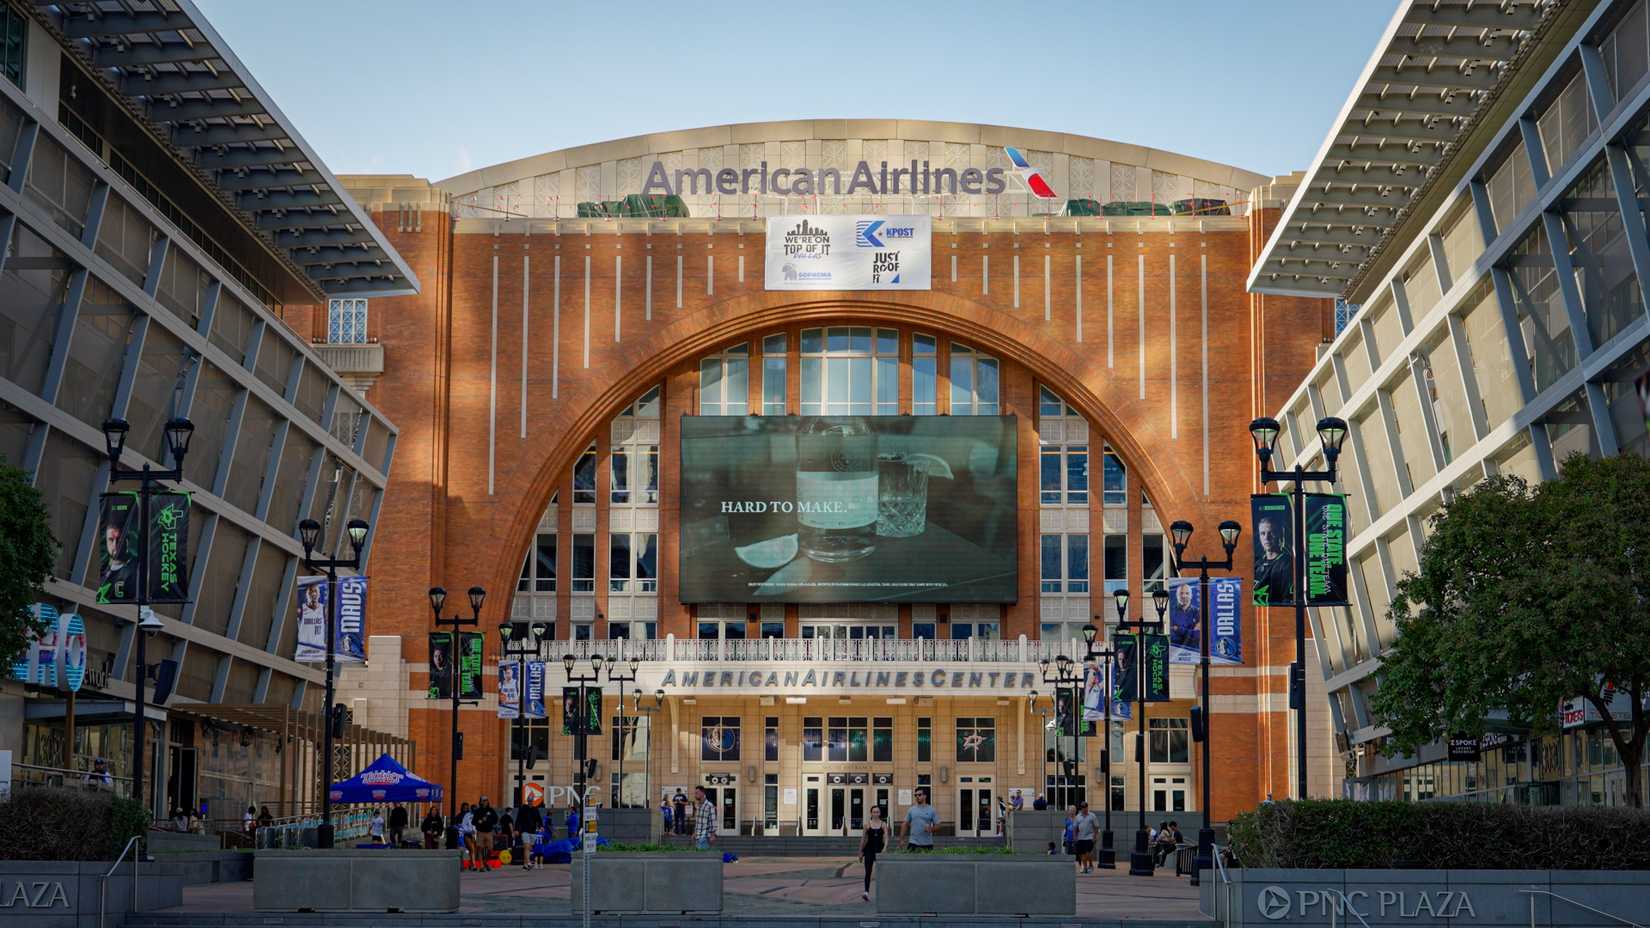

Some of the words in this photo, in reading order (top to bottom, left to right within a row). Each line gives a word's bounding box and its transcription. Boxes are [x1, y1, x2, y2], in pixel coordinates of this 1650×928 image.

[641, 159, 840, 195] American
[846, 159, 1008, 195] Airlines
[784, 244, 803, 256] TOP
[806, 244, 817, 253] OF
[821, 244, 831, 256] IT
[785, 236, 813, 244] WE'RE
[814, 236, 830, 244] ON
[873, 251, 900, 264] JUST
[873, 262, 900, 274] ROOF
[720, 501, 767, 513] HARD
[769, 501, 793, 513] TO
[796, 501, 848, 513] MAKE.
[160, 532, 170, 593] HOCKEY
[169, 532, 178, 584] TEXAS
[1216, 583, 1235, 636] DALLAS
[1296, 890, 1369, 917] PNC
[1376, 890, 1476, 917] PLAZA
